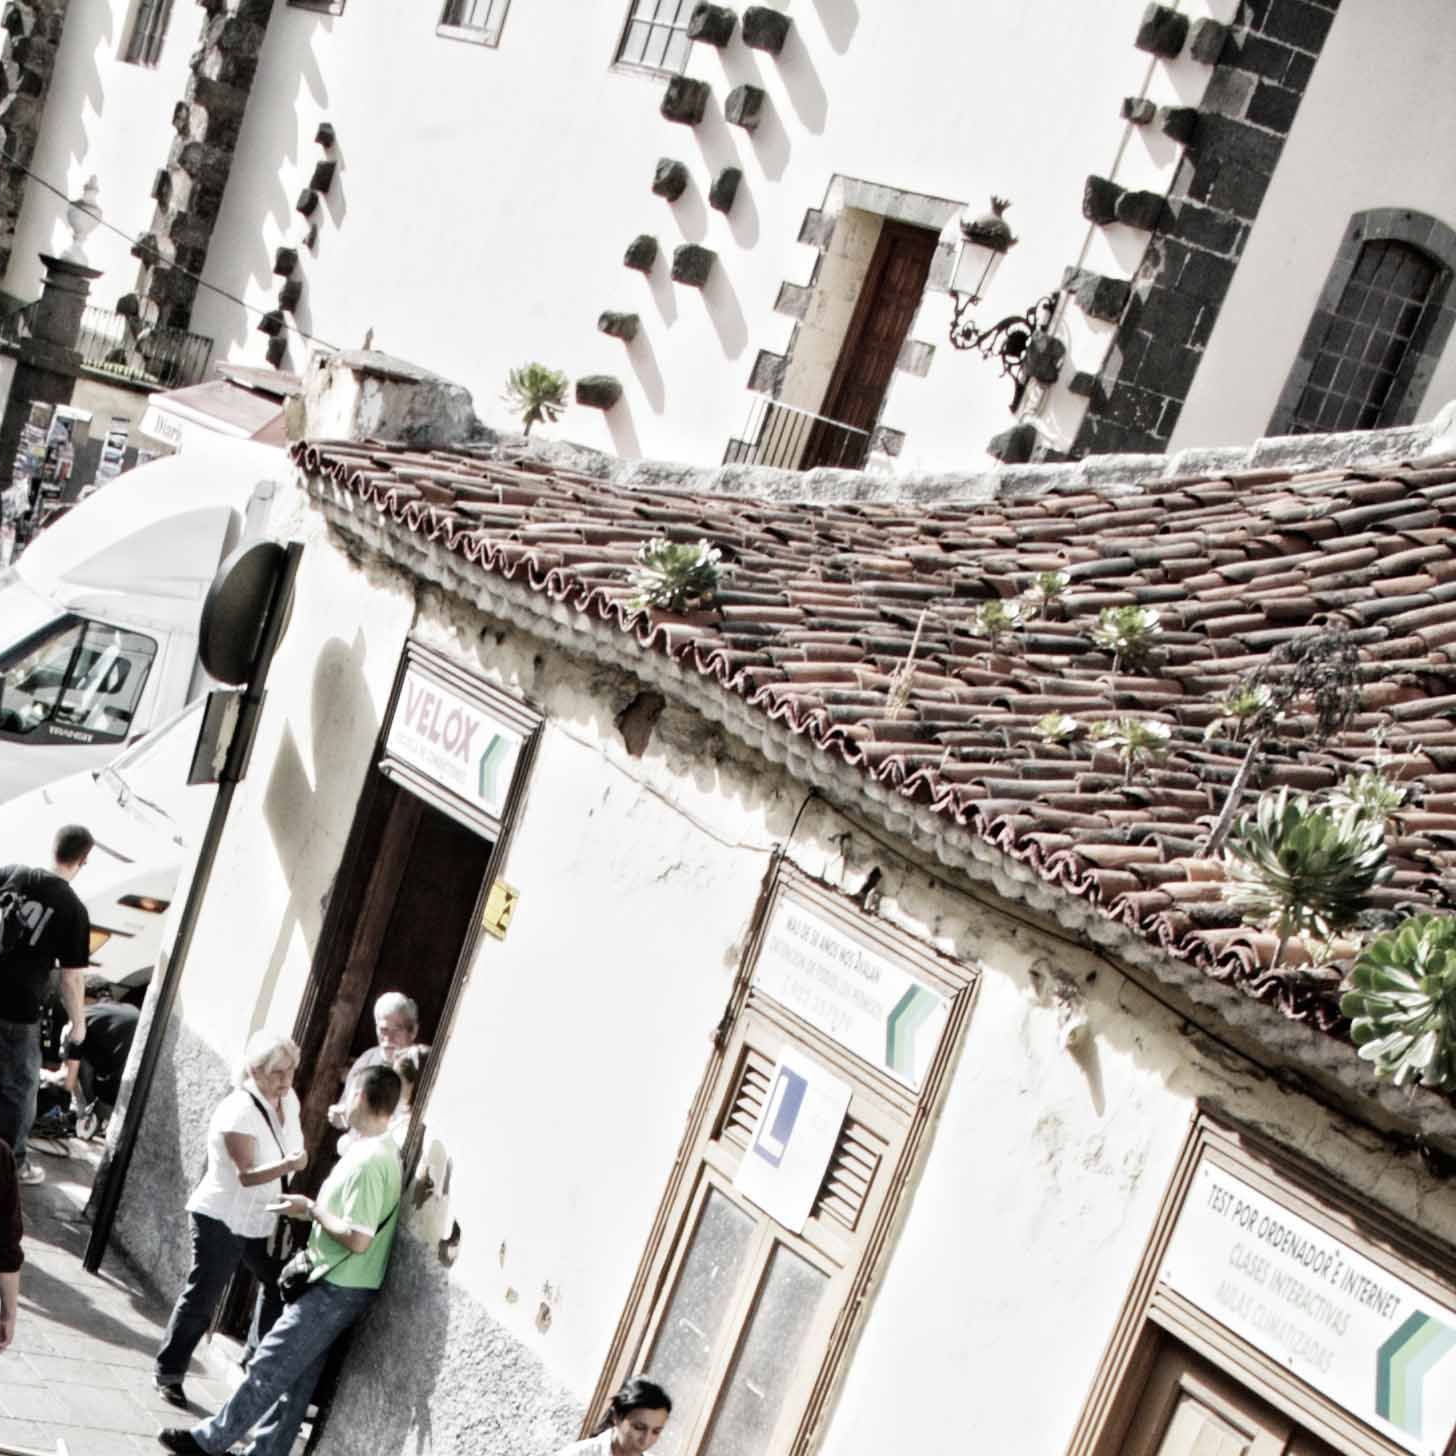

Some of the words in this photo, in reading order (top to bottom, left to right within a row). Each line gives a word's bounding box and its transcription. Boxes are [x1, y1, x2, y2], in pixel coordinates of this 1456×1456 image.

[48, 726, 94, 743] TRANSIT
[404, 678, 480, 764] VELOX
[1208, 1184, 1235, 1217] TEST
[1232, 1200, 1258, 1233] POR
[1257, 1216, 1334, 1280] ORDENADOR
[1339, 1266, 1401, 1321] INTERNET
[1228, 1241, 1271, 1285] CLASES
[1270, 1270, 1352, 1337] INTERACTIVAS
